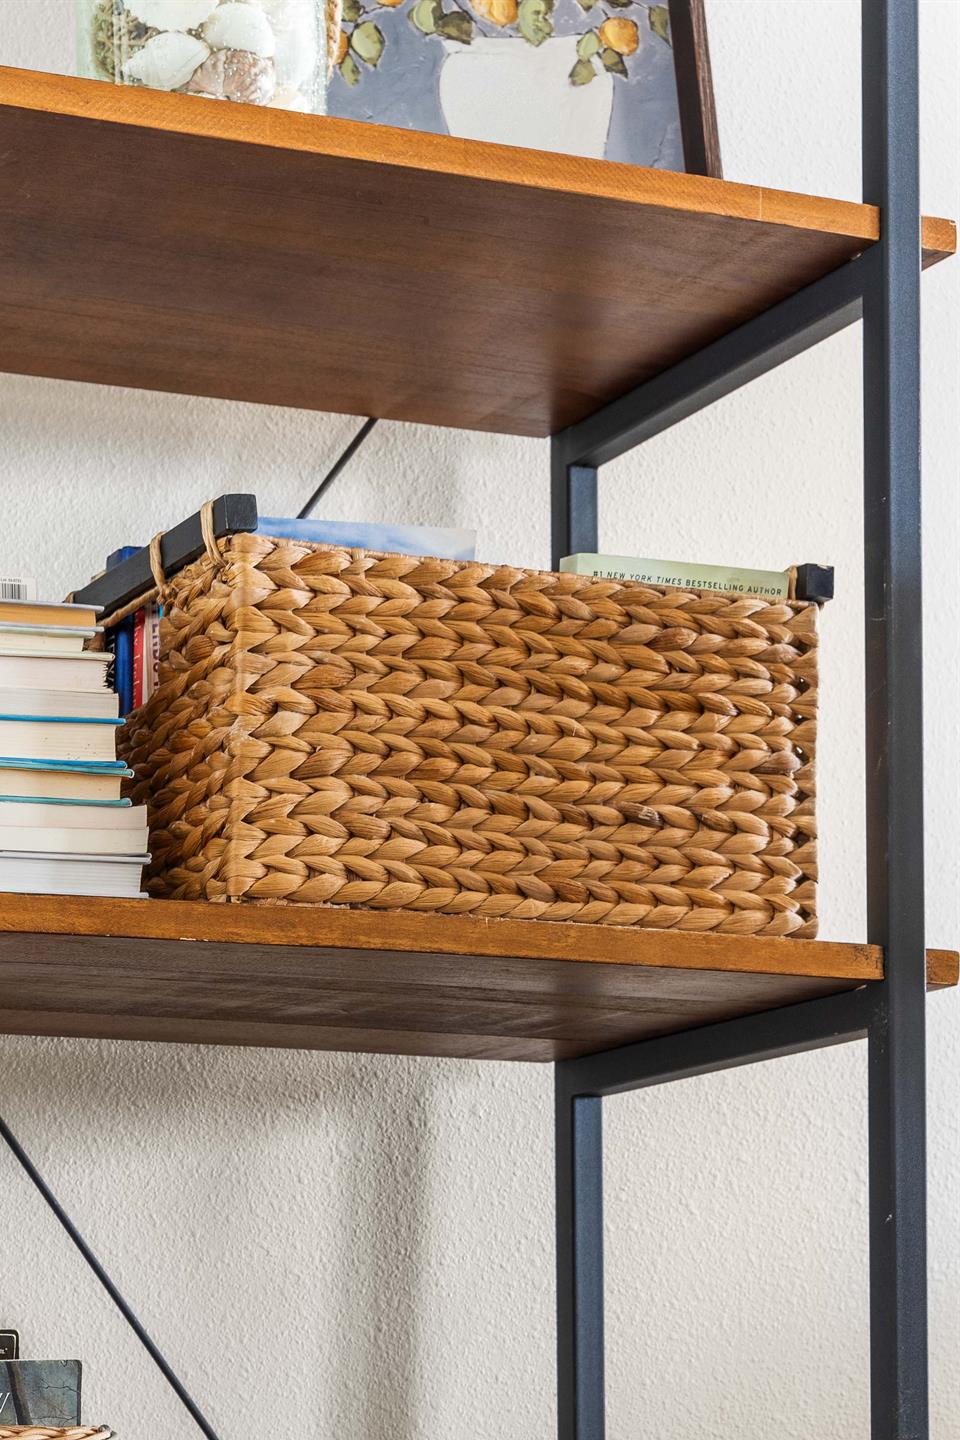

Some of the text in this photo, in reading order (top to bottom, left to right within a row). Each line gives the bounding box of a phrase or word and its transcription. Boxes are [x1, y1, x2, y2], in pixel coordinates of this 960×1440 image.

[607, 571, 625, 580] NEW
[630, 574, 652, 583] YORK
[656, 576, 682, 586] TIMES
[686, 579, 744, 592] BESTSELLING
[747, 586, 782, 596] AUTHOR
